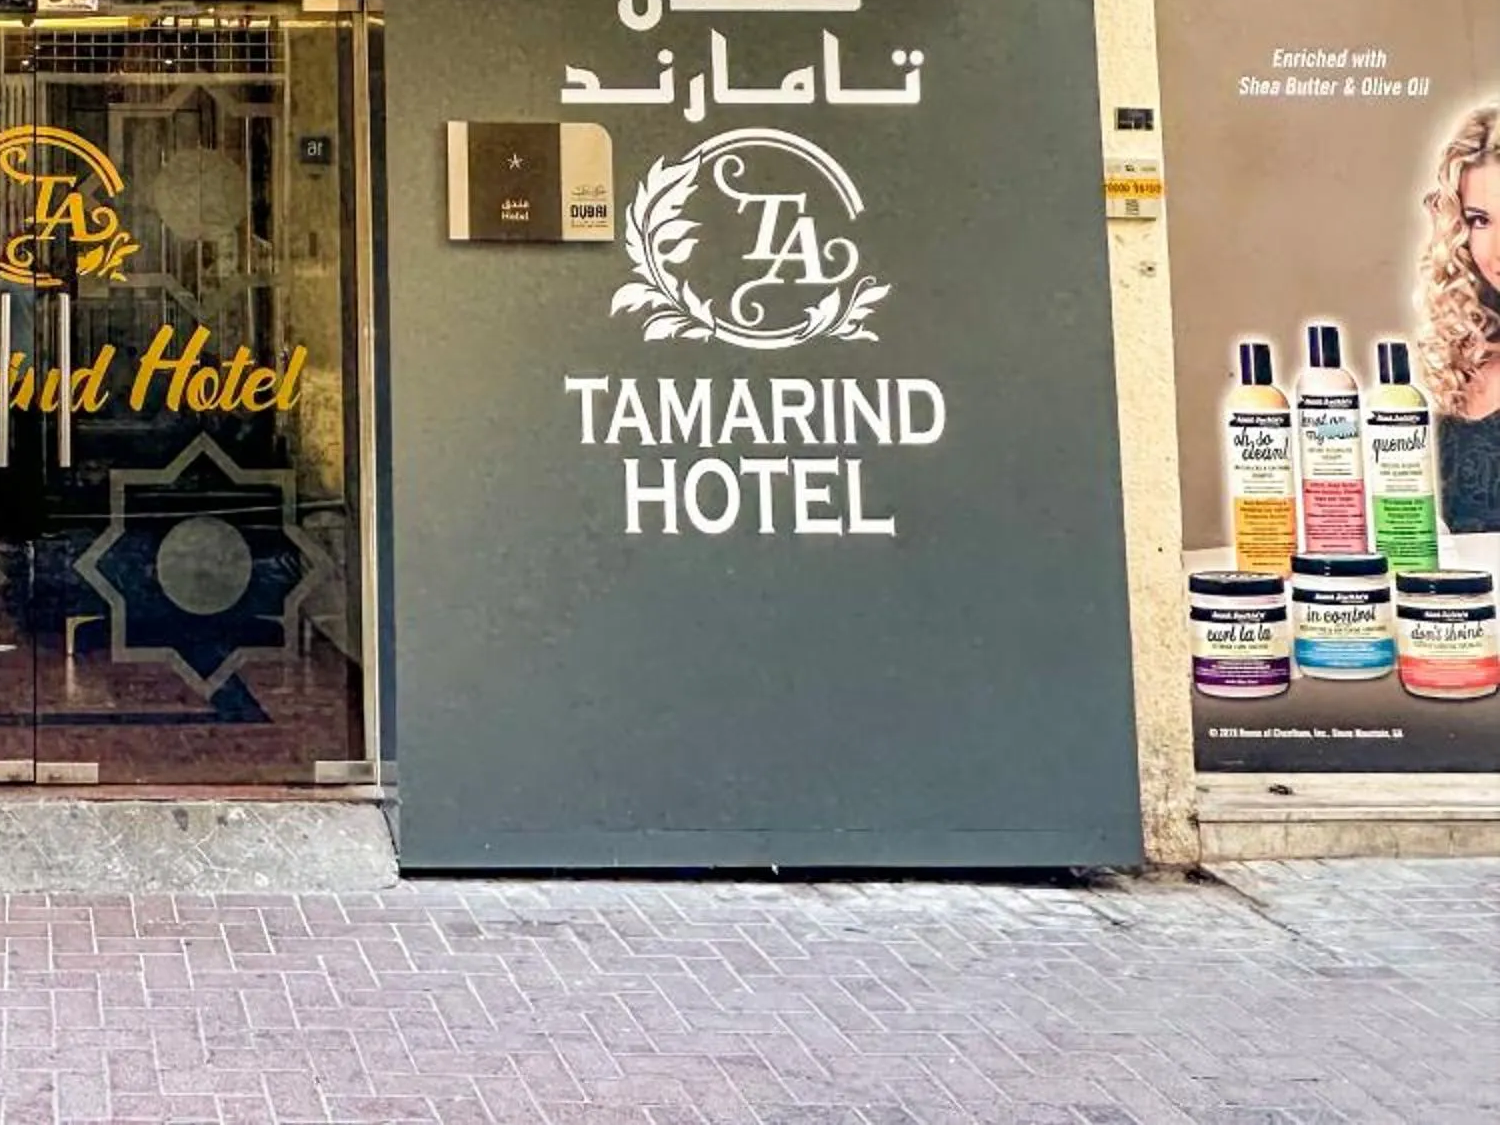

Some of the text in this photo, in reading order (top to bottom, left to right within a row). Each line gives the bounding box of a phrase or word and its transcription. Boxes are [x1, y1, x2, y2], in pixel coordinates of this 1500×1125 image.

[560, 28, 925, 123] تامارند
[1238, 76, 1430, 97] Shea Butter & Olive Oil
[1272, 48, 1387, 69] Enriched with
[570, 204, 607, 218] DUBAI
[129, 324, 308, 412] Hotel
[564, 375, 947, 448] TAMARIND
[623, 456, 897, 537] HOTEL
